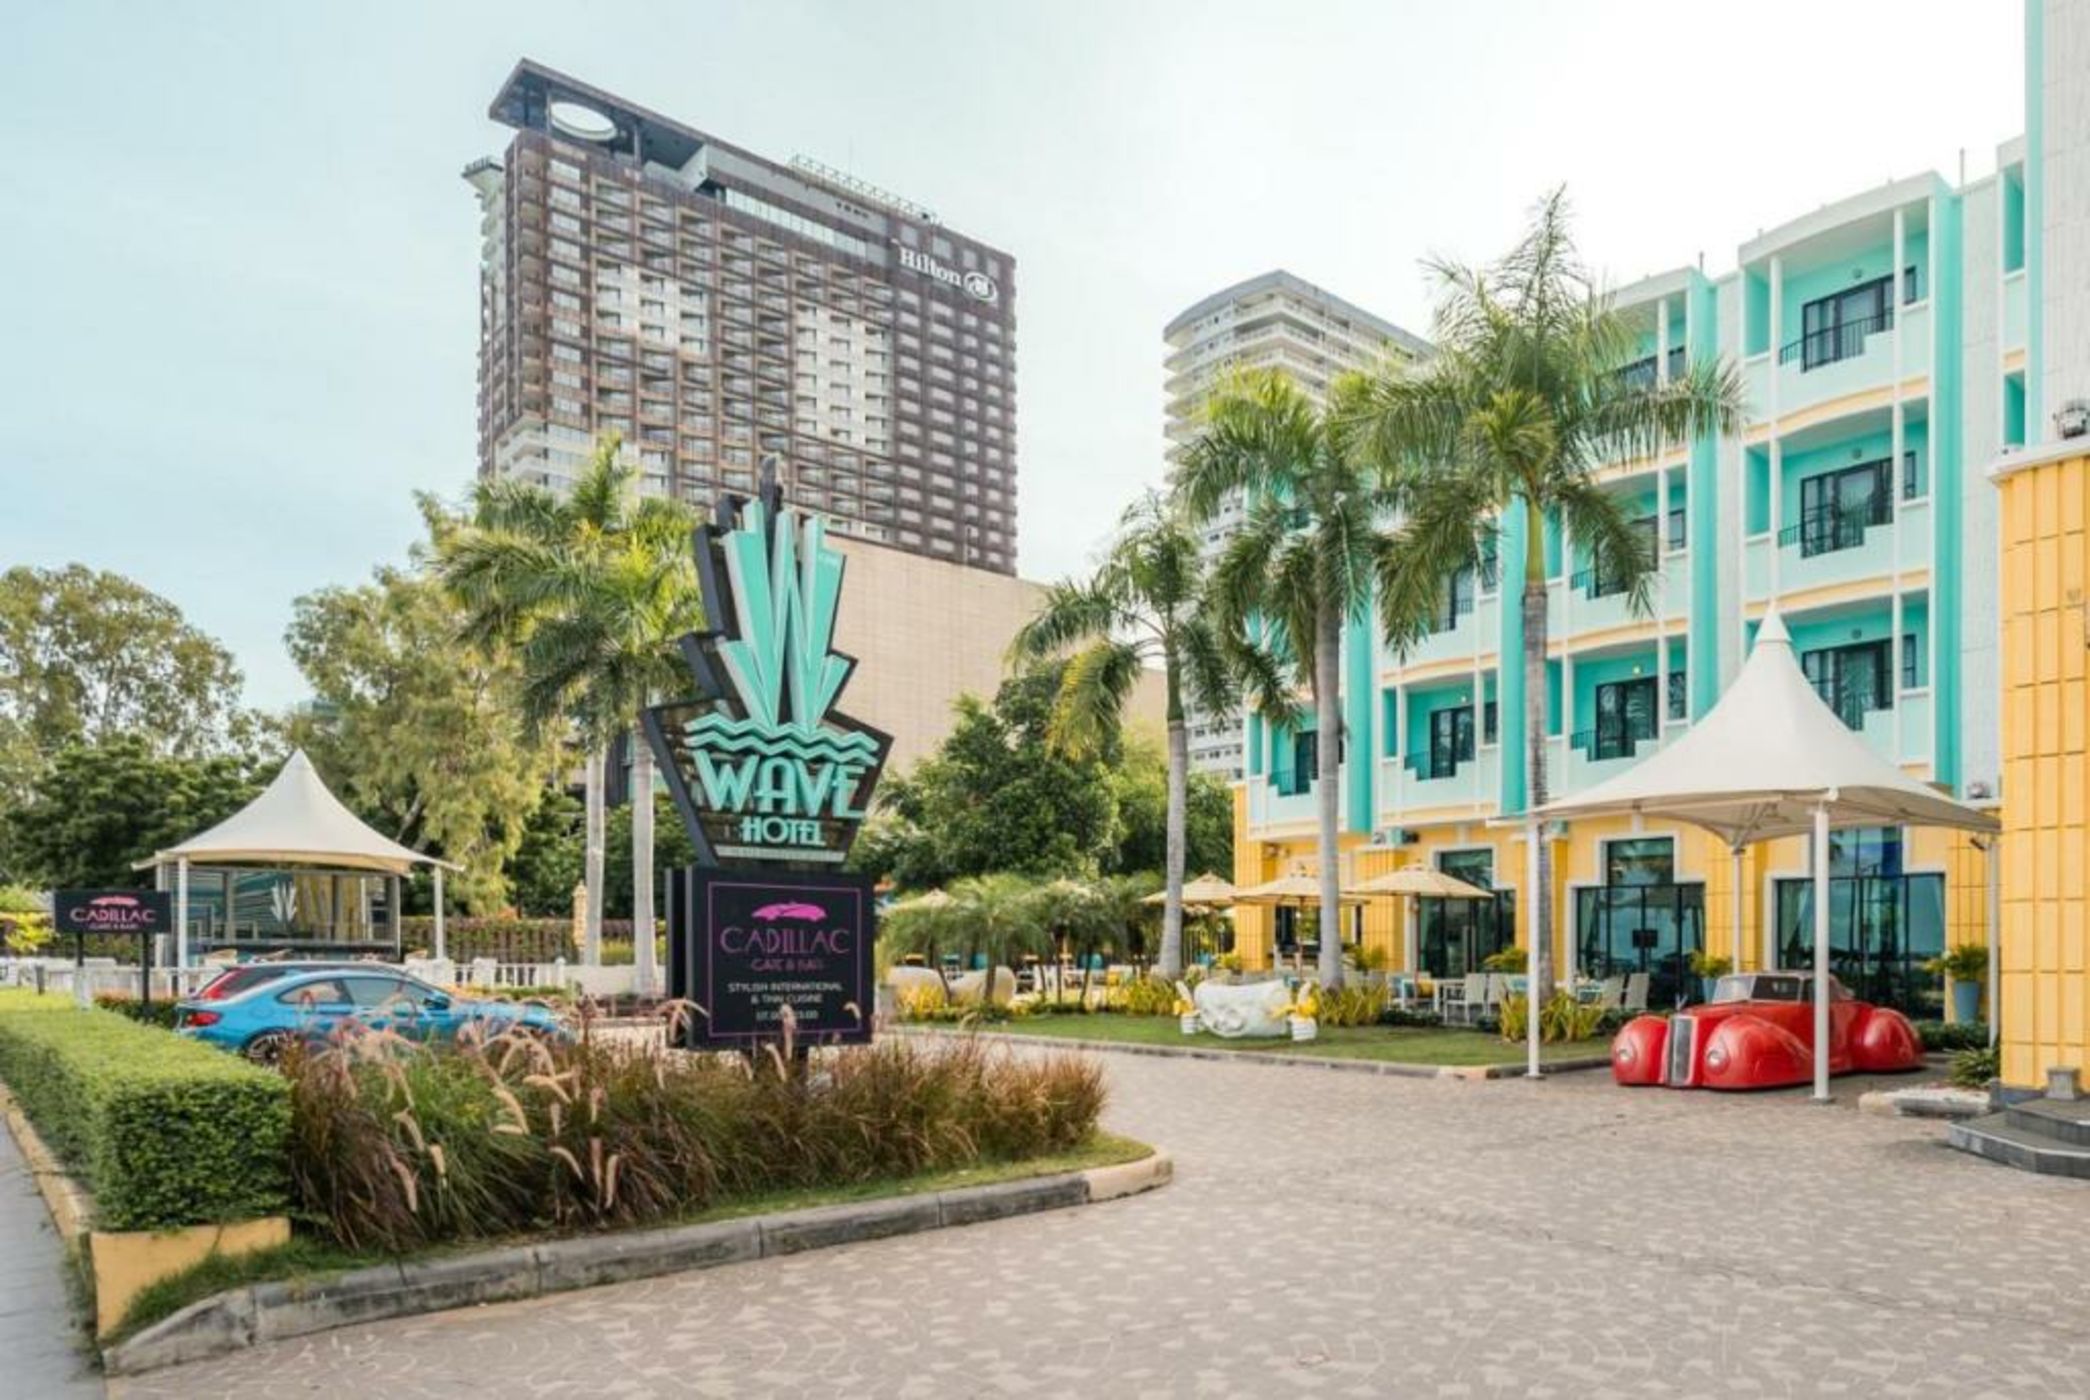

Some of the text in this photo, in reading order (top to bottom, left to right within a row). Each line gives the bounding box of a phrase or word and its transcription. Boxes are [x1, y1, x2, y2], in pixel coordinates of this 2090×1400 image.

[900, 245, 961, 287] Hilton
[693, 749, 866, 818] WAVE
[740, 816, 826, 846] HOTEL
[70, 907, 156, 923] CADILLAC
[720, 926, 850, 954] CADILLAC
[728, 982, 842, 992] STYLISH INTERNATIONAL
